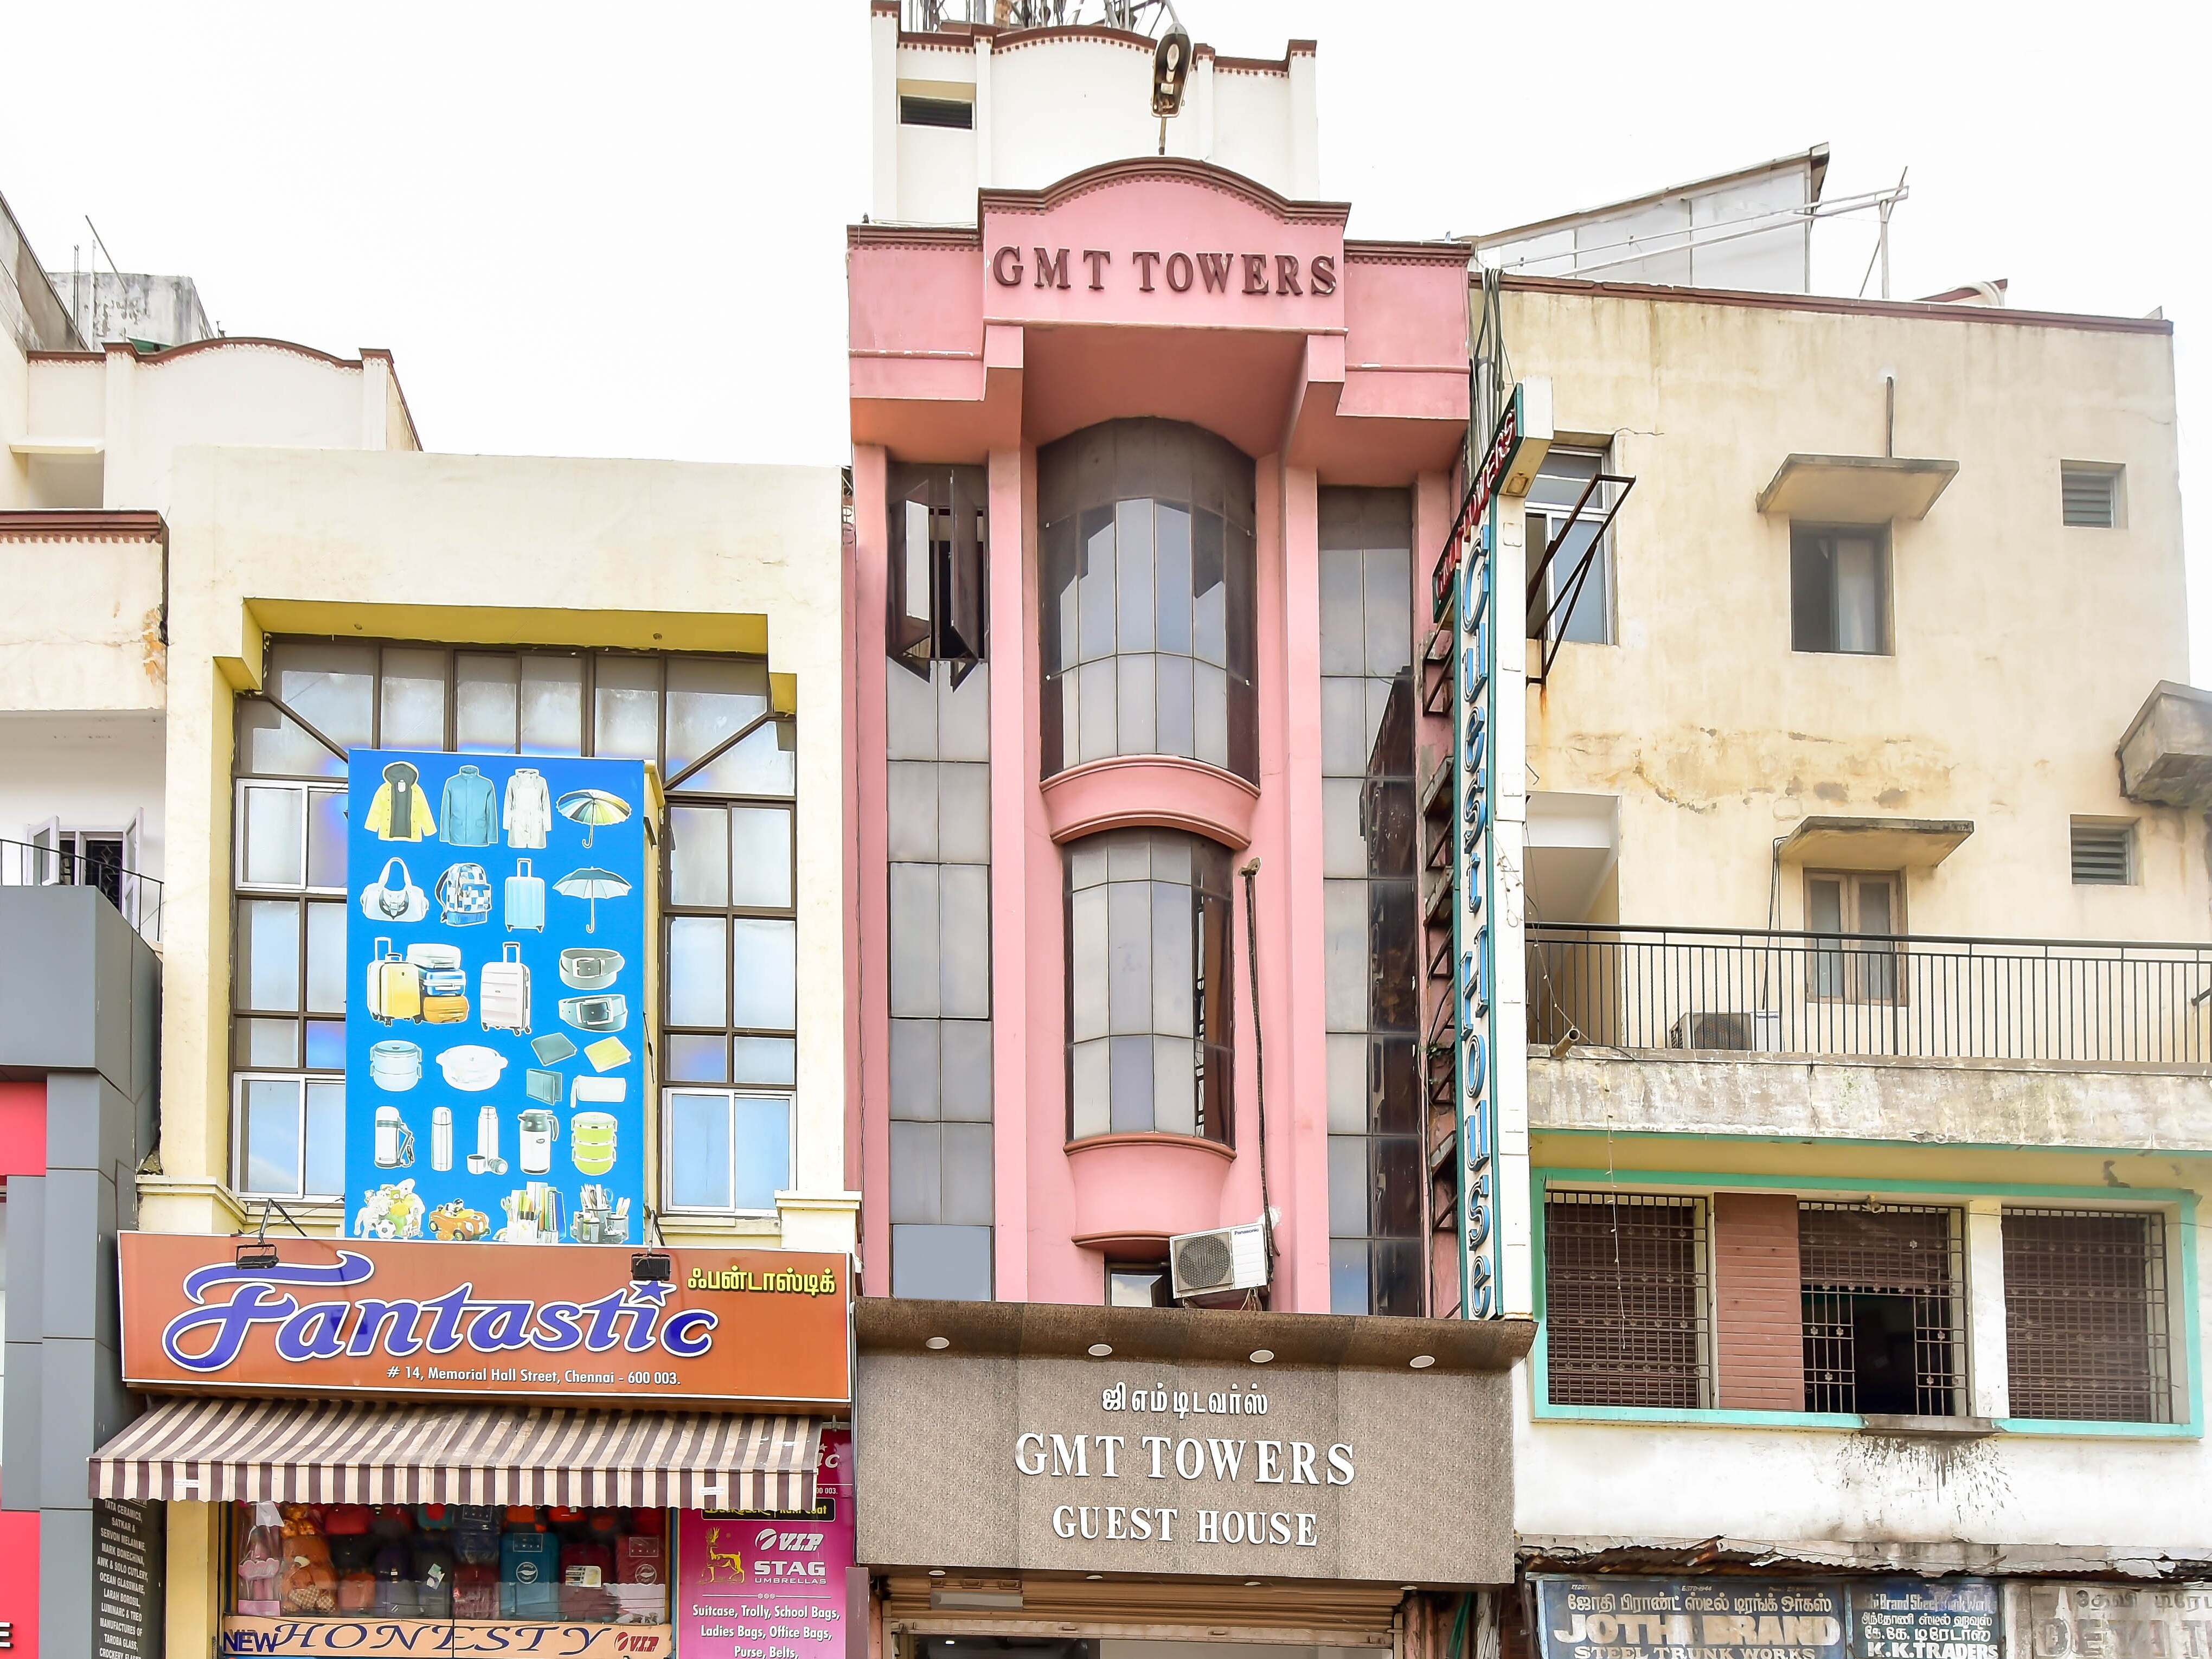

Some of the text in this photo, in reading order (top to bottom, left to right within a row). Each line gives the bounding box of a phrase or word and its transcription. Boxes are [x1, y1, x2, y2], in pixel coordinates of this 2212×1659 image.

[992, 246, 1336, 296] GMT TOWERS
[1458, 524, 1491, 1318] Guest House
[687, 1264, 836, 1297] ஃபன்டாஸ்டிக்
[162, 1250, 719, 1372] Fantastic
[406, 1366, 424, 1381] 14,
[428, 1367, 487, 1381] Memorial
[491, 1368, 516, 1382] Hall
[520, 1369, 561, 1385] Street,
[565, 1369, 614, 1384] Chennai
[627, 1371, 651, 1384] 600
[653, 1372, 681, 1385] 003.
[1015, 1432, 1356, 1485] GMT TOWERS
[105, 1499, 116, 1512] TATA
[117, 1504, 143, 1523] CERAMICS,
[1053, 1505, 1318, 1547] GUEST HOUSE
[101, 1542, 116, 1556] MARK
[114, 1561, 127, 1574] SOLO
[127, 1566, 148, 1583] CUTLERY,
[754, 1561, 826, 1577] STAG
[99, 1572, 145, 1596] OCEAN GLASSWARE,
[104, 1588, 141, 1609] LARAH BOROSIL,
[1568, 1593, 1615, 1613] ஜோதி
[1620, 1591, 1682, 1613] பிராண்ட்
[1685, 1592, 1730, 1612] ஸ்டீல்
[101, 1602, 125, 1617] LUMINARC
[130, 1611, 142, 1622] TREO
[693, 1604, 840, 1621] Suitcase, Trolly, School Bags,
[100, 1617, 143, 1637] MANUFACTURES OF
[701, 1625, 832, 1641] Ladies Bags, Office Bags,
[1702, 1615, 1841, 1646] BRAND
[104, 1634, 138, 1652] TAROBA GLASS,
[223, 1631, 279, 1652] NEW
[266, 1623, 612, 1655] HONESTY
[734, 1646, 798, 1659] Purse, Belts,
[1574, 1645, 1817, 1659] STEEL TRUNK WORKS
